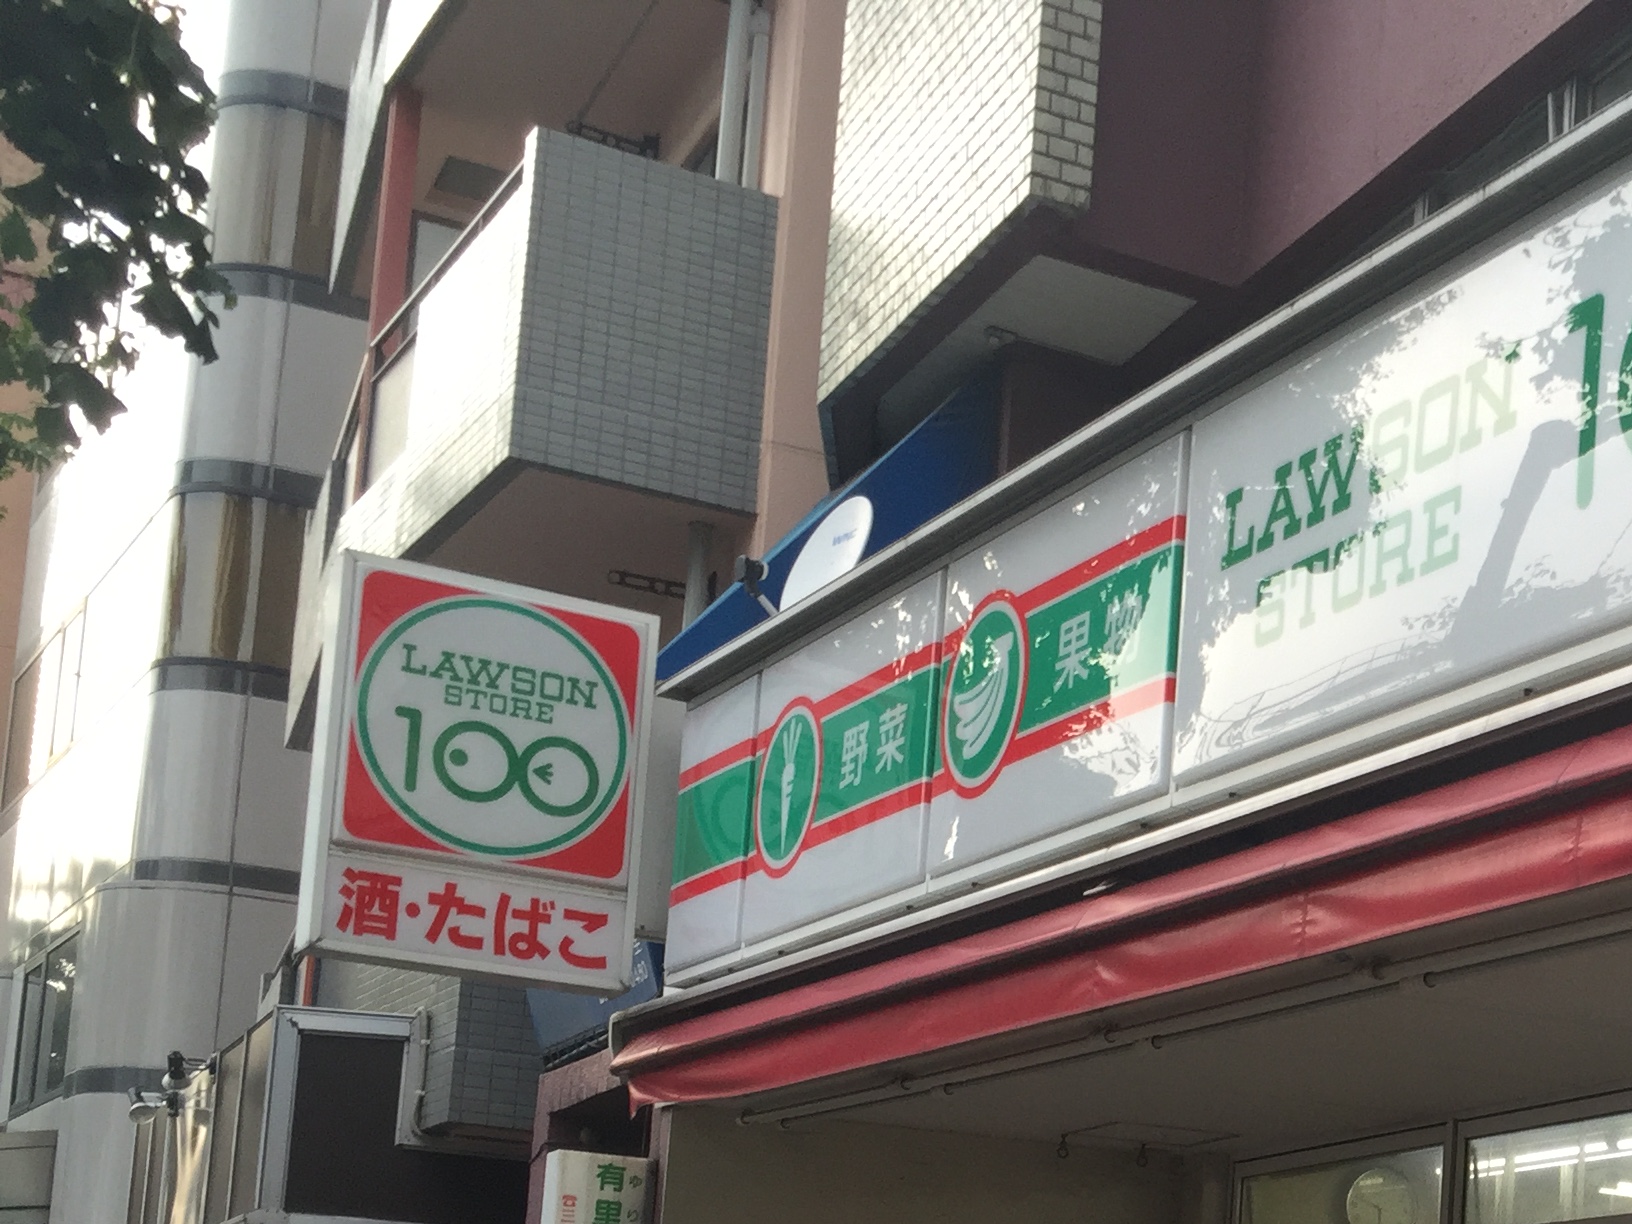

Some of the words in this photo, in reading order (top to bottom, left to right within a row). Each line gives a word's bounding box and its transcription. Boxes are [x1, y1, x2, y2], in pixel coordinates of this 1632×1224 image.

[1220, 339, 1523, 571] LAWSON
[1253, 485, 1463, 648] STORE
[400, 643, 598, 710] LAWSON
[444, 684, 554, 725] STORE
[394, 706, 600, 818] 100
[839, 702, 909, 790] 野菜
[336, 867, 609, 970] 酒・たばこ
[626, 1175, 643, 1222] ゆり
